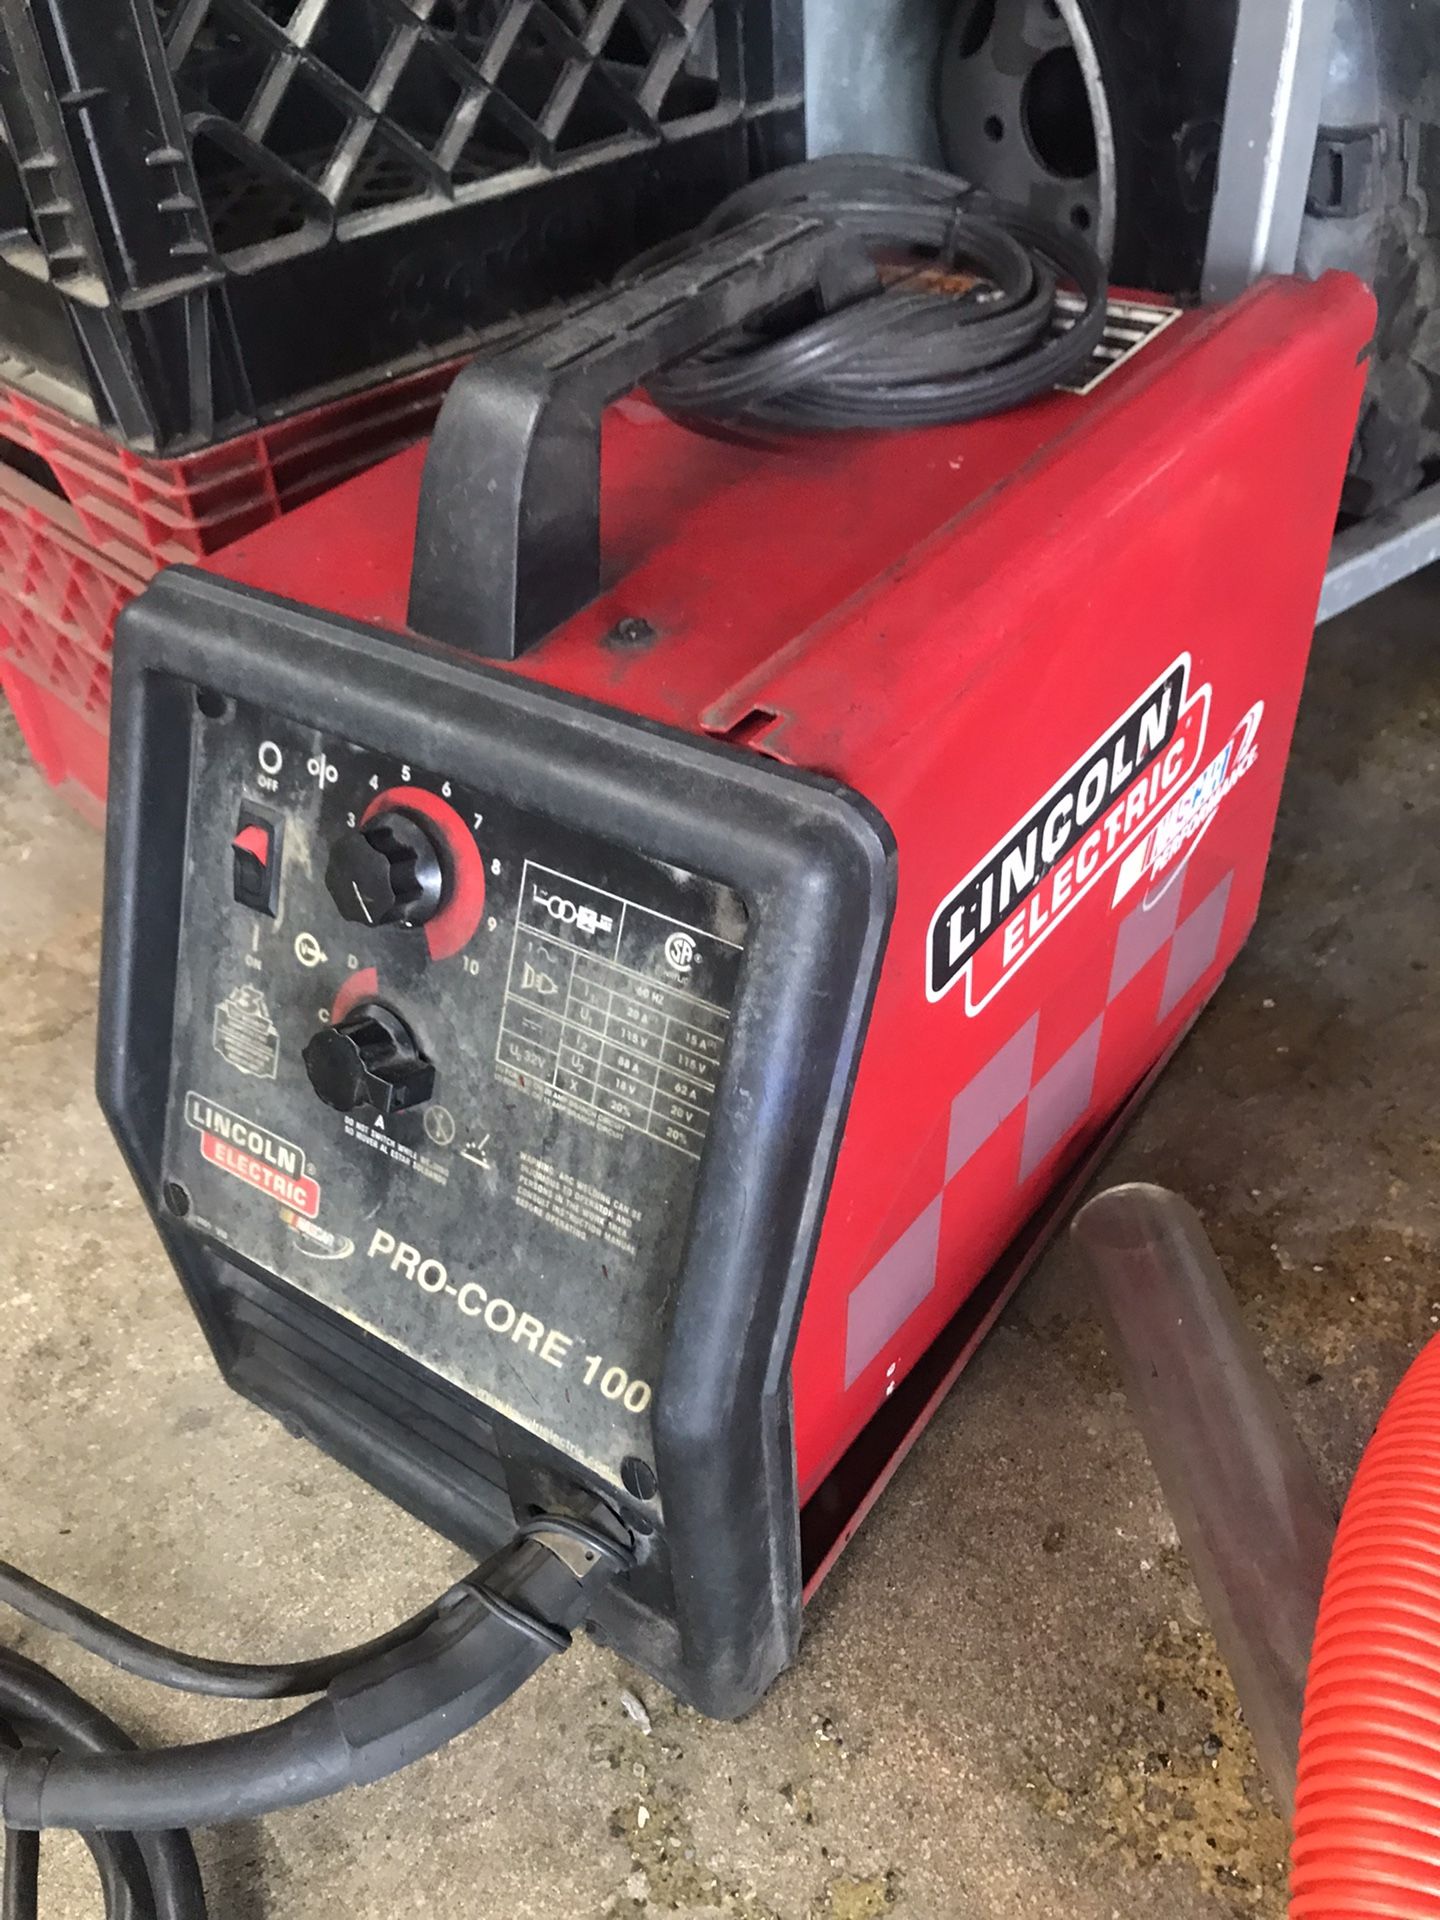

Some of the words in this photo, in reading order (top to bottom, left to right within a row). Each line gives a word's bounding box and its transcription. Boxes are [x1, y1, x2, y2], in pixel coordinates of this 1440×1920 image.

[257, 773, 279, 792] OFF
[369, 774, 379, 791] 4
[401, 765, 411, 782] 5
[441, 780, 452, 797] 6
[346, 812, 356, 828] 3
[473, 812, 483, 830] 7
[949, 686, 1172, 967] LINCOLN
[1003, 737, 1185, 967] ELECTRIC
[490, 858, 501, 876] 8
[487, 916, 497, 932] 9
[245, 953, 262, 970] ON
[347, 953, 358, 969] D
[462, 955, 479, 976] 10
[318, 1007, 330, 1023] C
[640, 1037, 649, 1048] V
[569, 1077, 578, 1092] X
[632, 1063, 640, 1074] A
[674, 1082, 687, 1096] 62
[688, 1089, 697, 1100] A
[629, 1084, 637, 1095] V
[670, 1104, 683, 1118] 20
[684, 1110, 694, 1122] V
[373, 1113, 385, 1130] A
[193, 1101, 297, 1173] LINCOLN
[214, 1142, 308, 1206] ELECTRIC
[519, 1174, 553, 1199] PERSONS
[566, 1199, 580, 1213] THE
[582, 1207, 605, 1225] WORK
[562, 1185, 573, 1197] TO
[574, 1191, 614, 1218] OPERATOR
[615, 1213, 632, 1228] AND
[613, 1199, 630, 1214] CAN
[517, 1185, 550, 1208] CONSULT
[603, 1231, 637, 1256] MANUAL
[367, 1227, 573, 1369] PRO-CORE
[582, 1354, 652, 1414] 100
